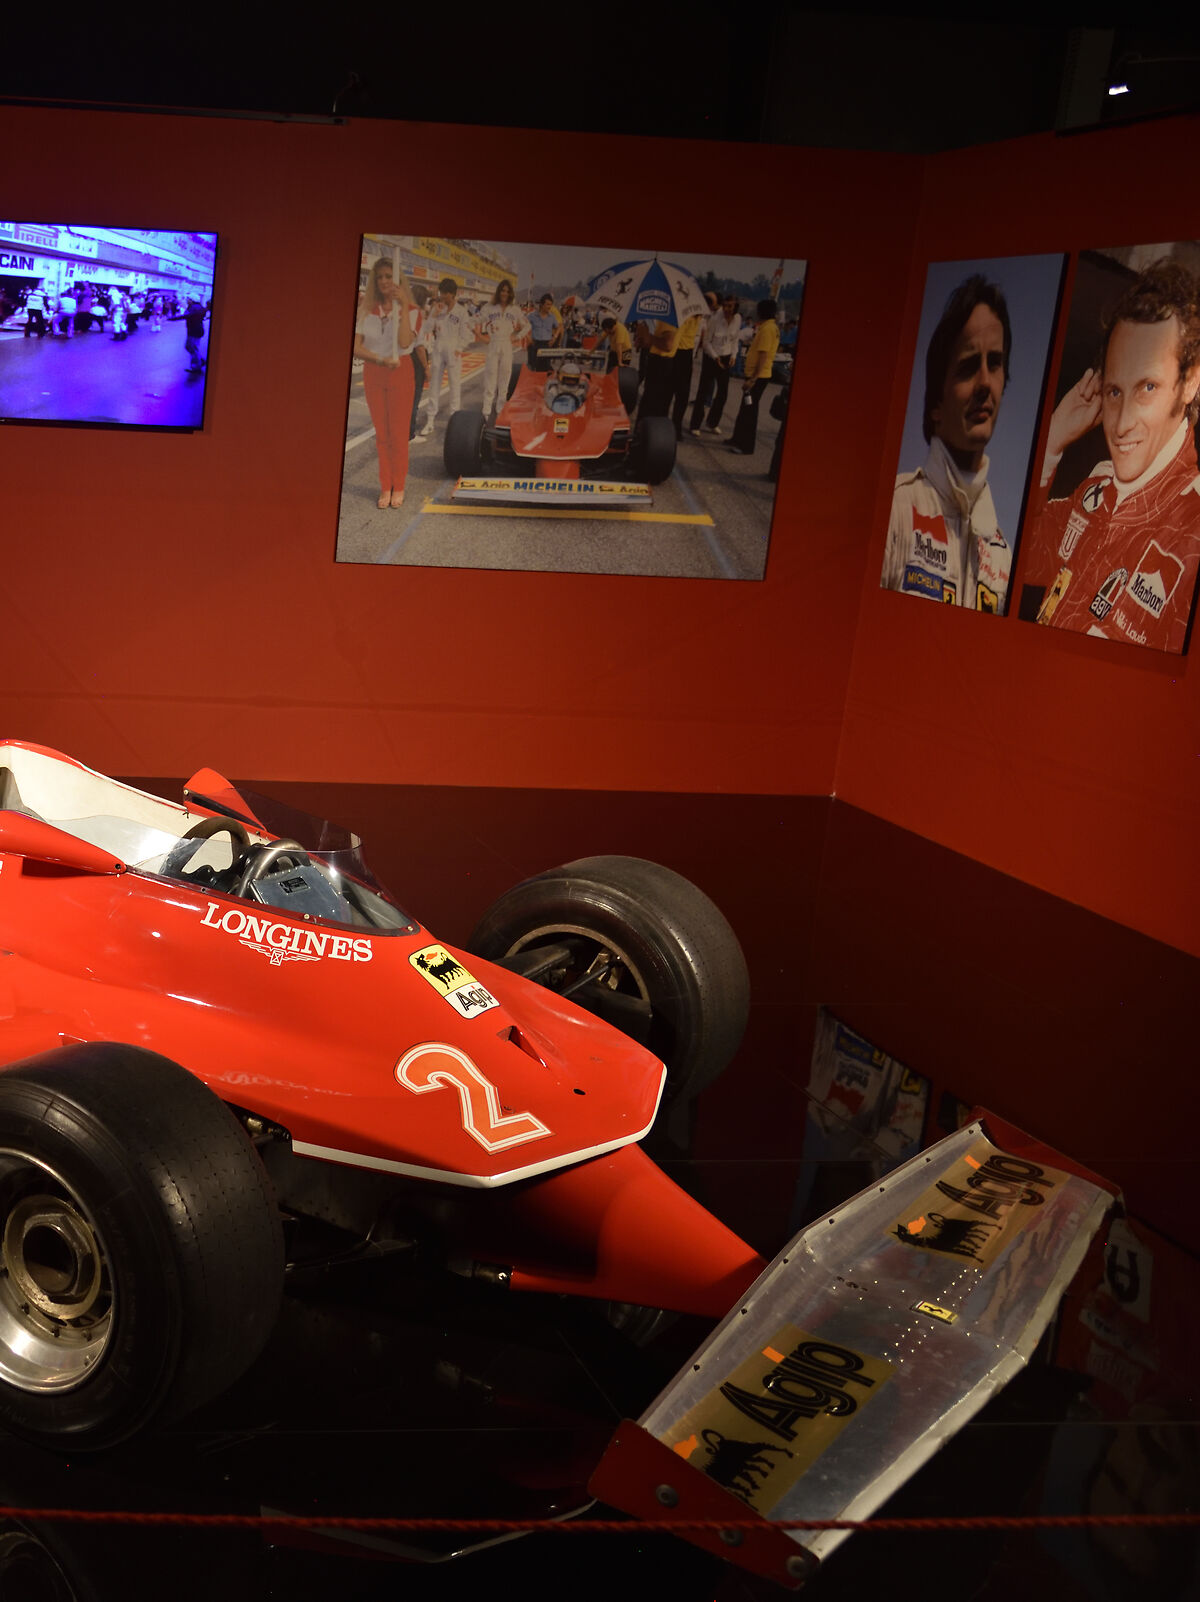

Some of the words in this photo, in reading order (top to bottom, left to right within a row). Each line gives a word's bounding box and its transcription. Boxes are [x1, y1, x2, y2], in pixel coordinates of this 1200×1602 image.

[514, 481, 594, 493] MICHELIN
[907, 571, 941, 591] MICHELIN
[1131, 574, 1163, 613] Marlboro
[200, 902, 373, 962] LONGINES
[456, 985, 494, 1011] Agip
[393, 1040, 556, 1156] 2
[935, 1154, 1056, 1221] Agip
[719, 1339, 877, 1441] Agip
